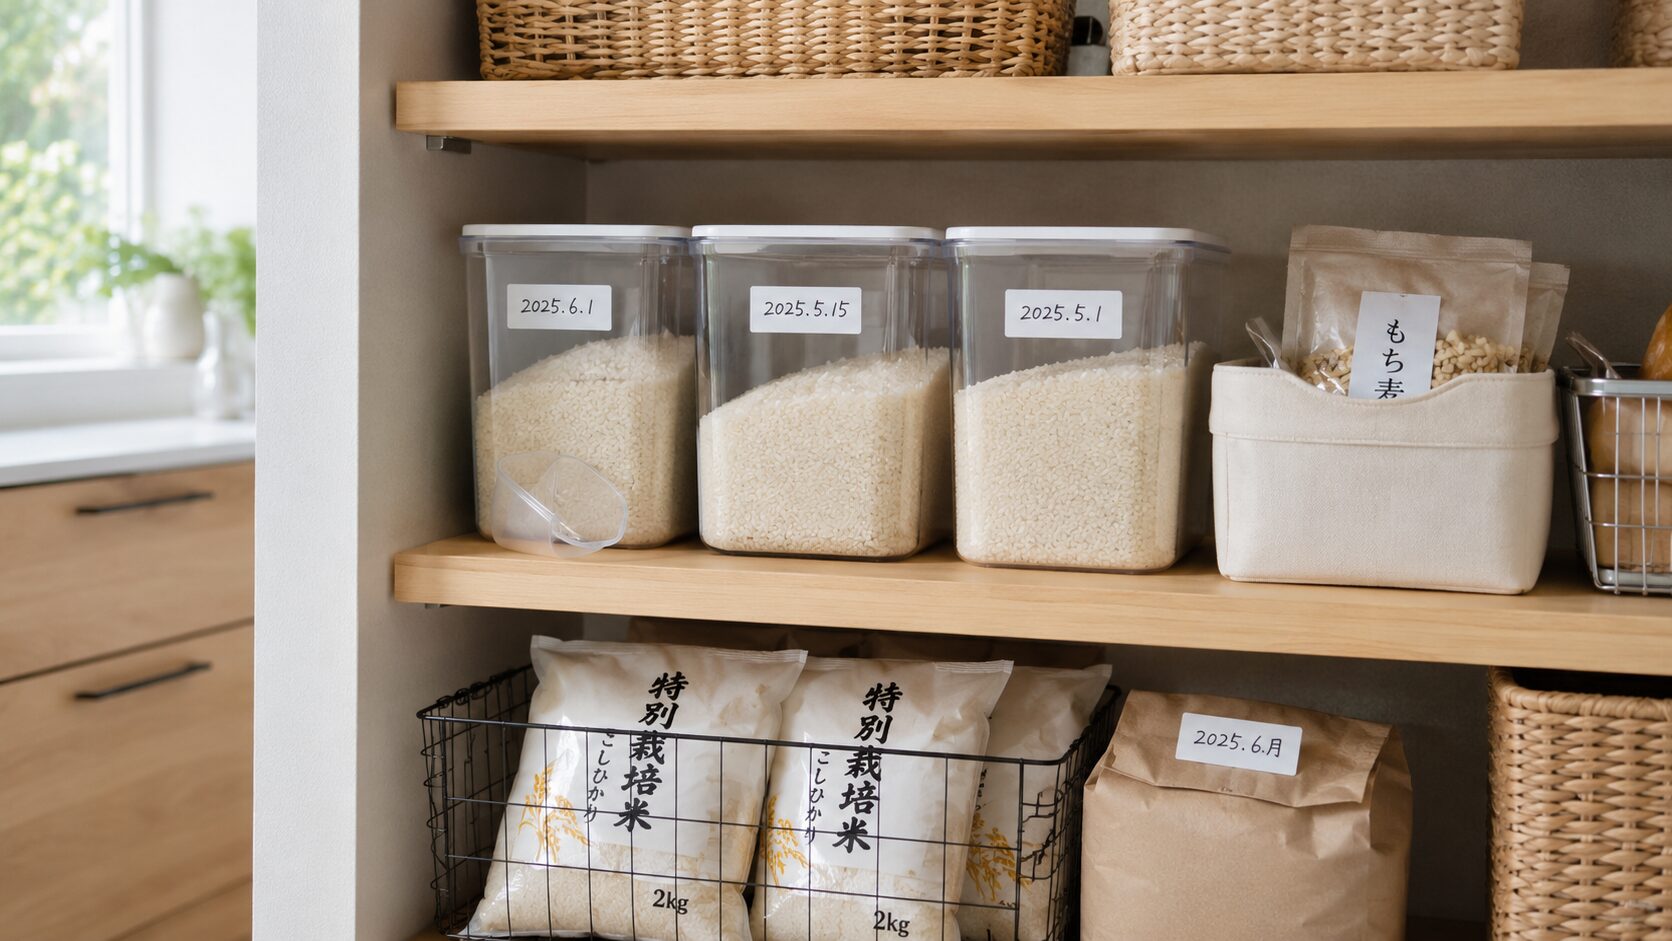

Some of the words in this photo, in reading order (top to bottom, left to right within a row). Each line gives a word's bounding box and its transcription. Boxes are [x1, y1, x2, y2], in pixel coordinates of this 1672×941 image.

[520, 297, 594, 316] 2025.6.1
[763, 299, 850, 319] 2025.5.15
[1020, 303, 1103, 323] 2025.5.1
[1374, 319, 1405, 399] もち麦
[613, 671, 689, 833] 特別栽培米
[1193, 729, 1283, 759] 2025.6.月
[583, 729, 615, 823] こしひかり
[832, 682, 903, 853] 特別栽培米
[804, 751, 831, 845] こしひかり
[653, 888, 689, 915] 2kg
[873, 909, 910, 937] 2kg
